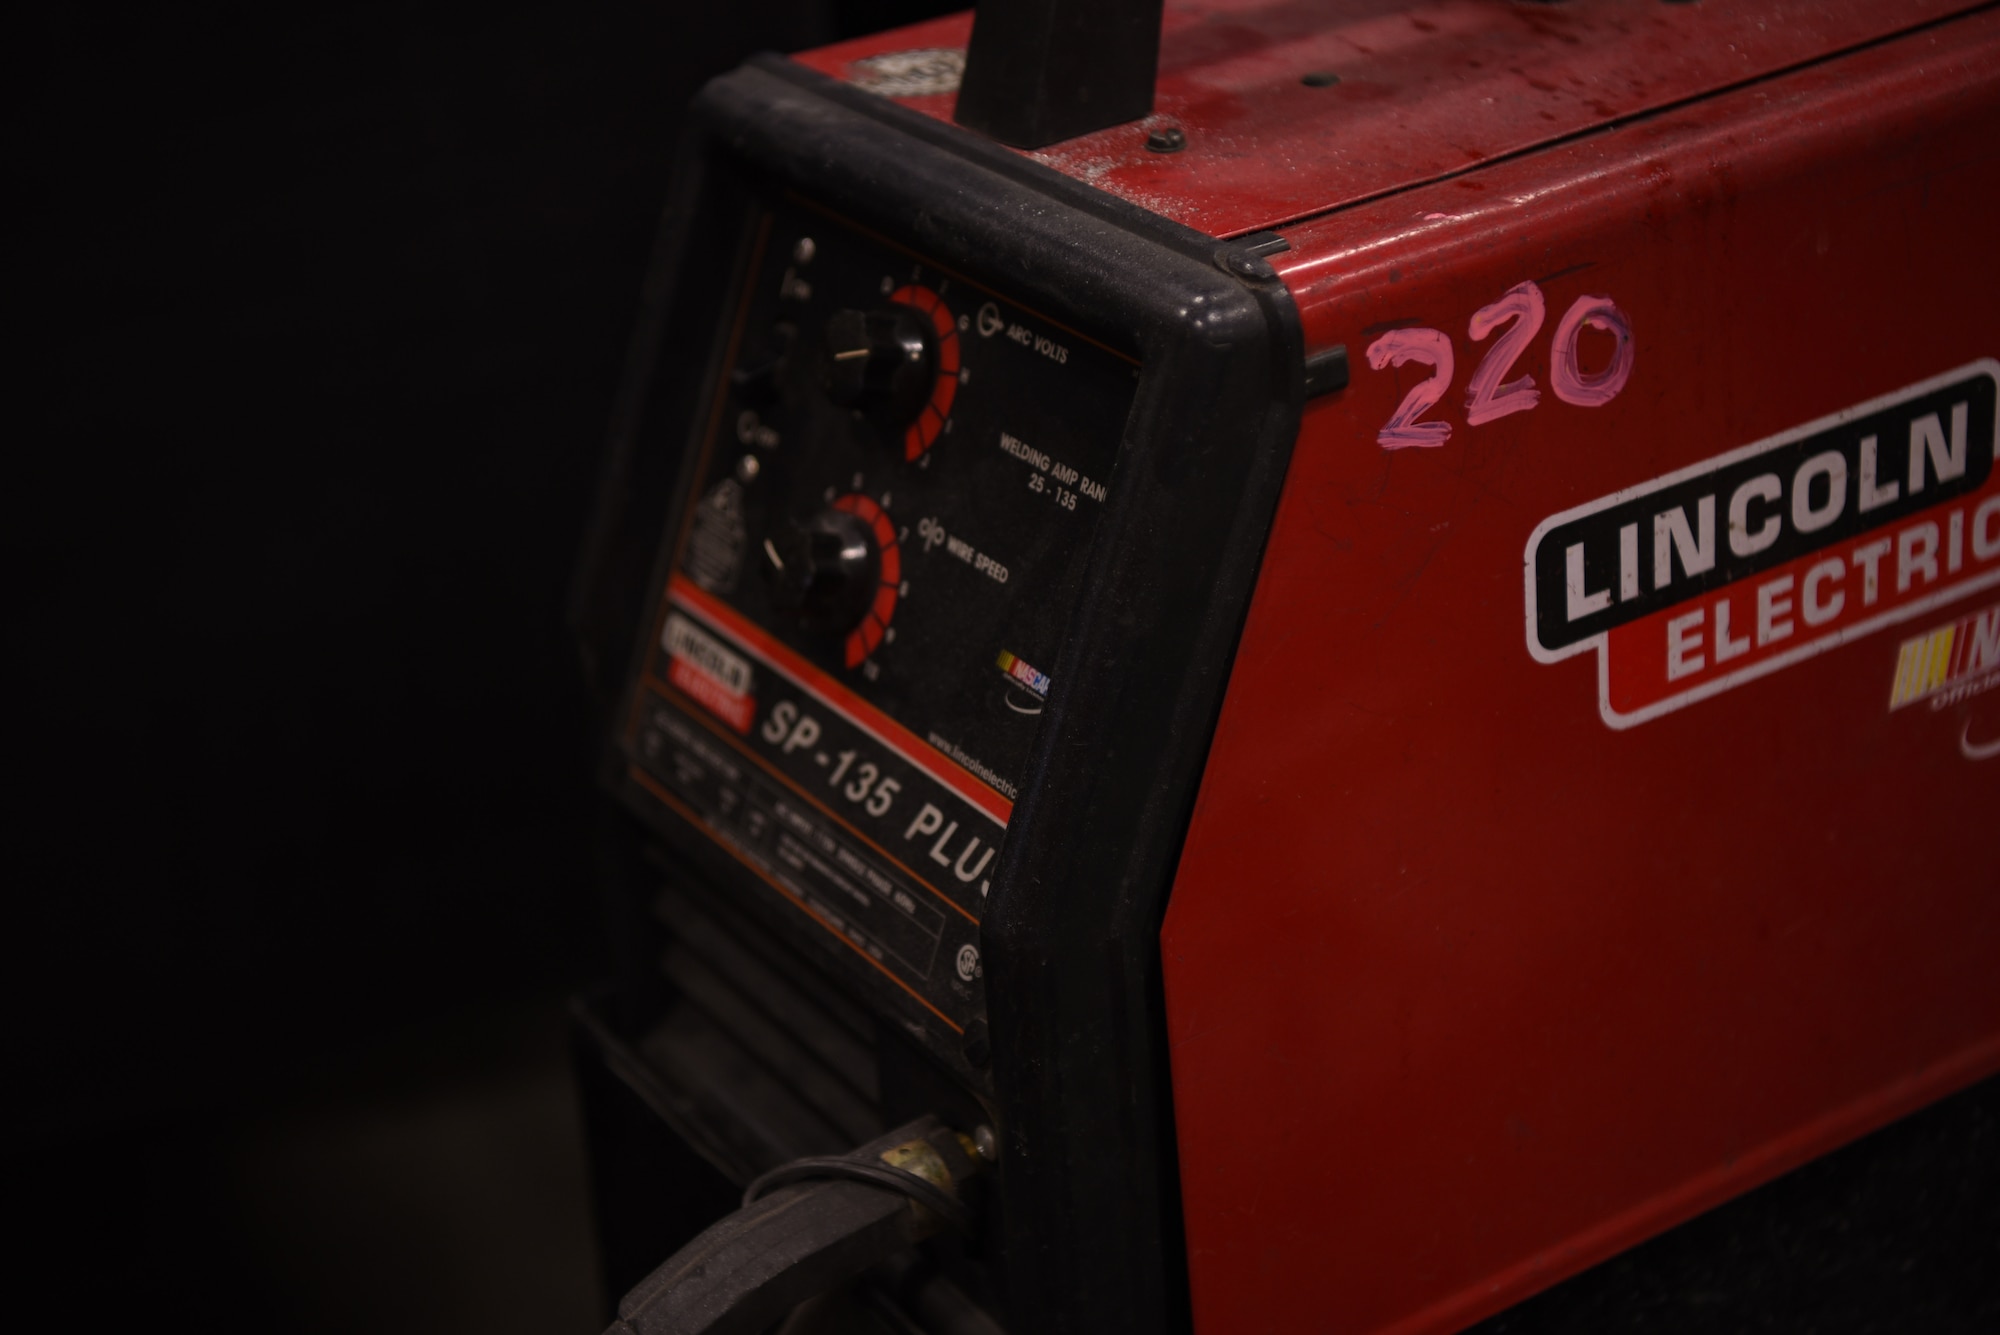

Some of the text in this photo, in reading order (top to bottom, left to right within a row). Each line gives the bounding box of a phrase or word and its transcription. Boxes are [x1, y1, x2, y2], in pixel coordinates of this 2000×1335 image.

[1006, 322, 1070, 364] ARC VOLTS
[1366, 279, 1635, 450] 220
[1000, 431, 1108, 503] WELDING AMP RAN
[1028, 472, 1046, 493] 25
[1055, 486, 1078, 512] 135
[1565, 400, 1969, 623] LINCOLN
[946, 534, 1009, 584] WIRE SPEED
[1667, 493, 2000, 683] ELECTRIC
[761, 699, 902, 817] SP-135
